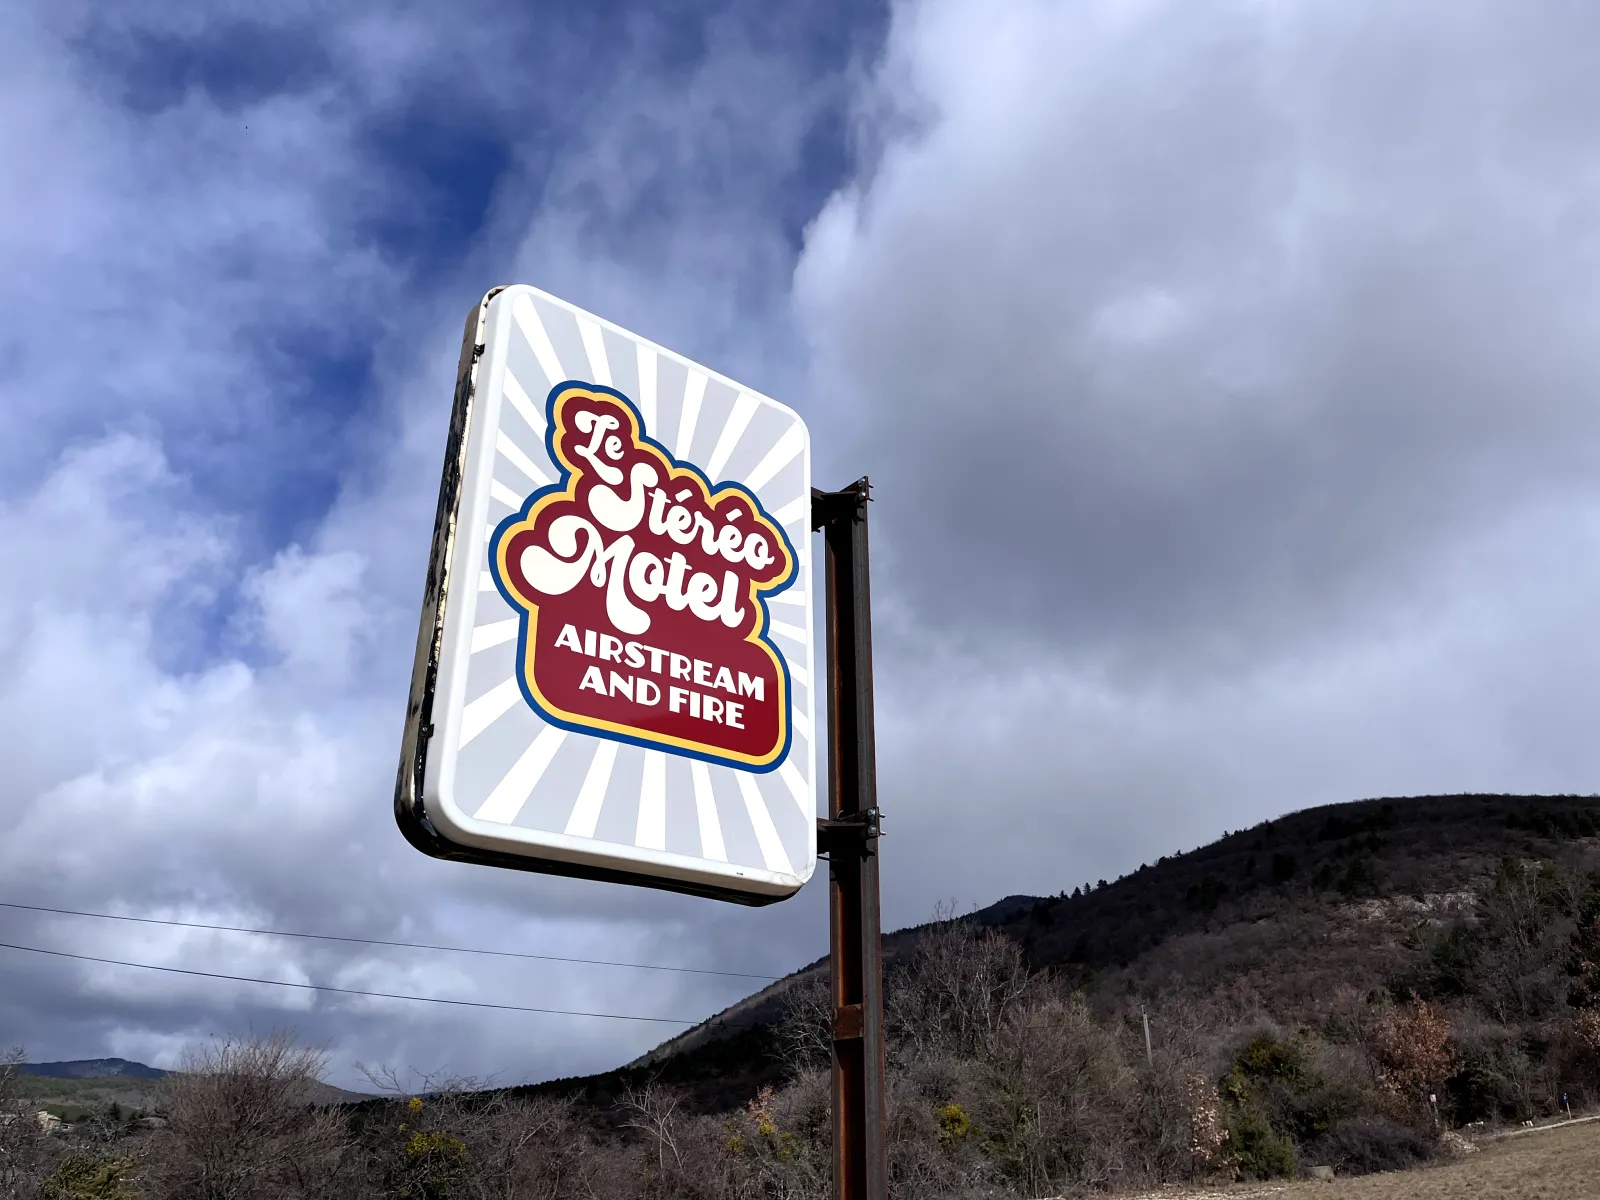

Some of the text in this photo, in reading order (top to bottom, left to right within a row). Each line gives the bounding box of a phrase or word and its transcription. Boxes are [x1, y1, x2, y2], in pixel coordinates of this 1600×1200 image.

[574, 410, 624, 485] Le
[588, 463, 775, 571] Stéréo
[520, 515, 745, 635] Motel
[554, 623, 765, 702] AIRSTREAM
[579, 665, 745, 730] AND FIRE
